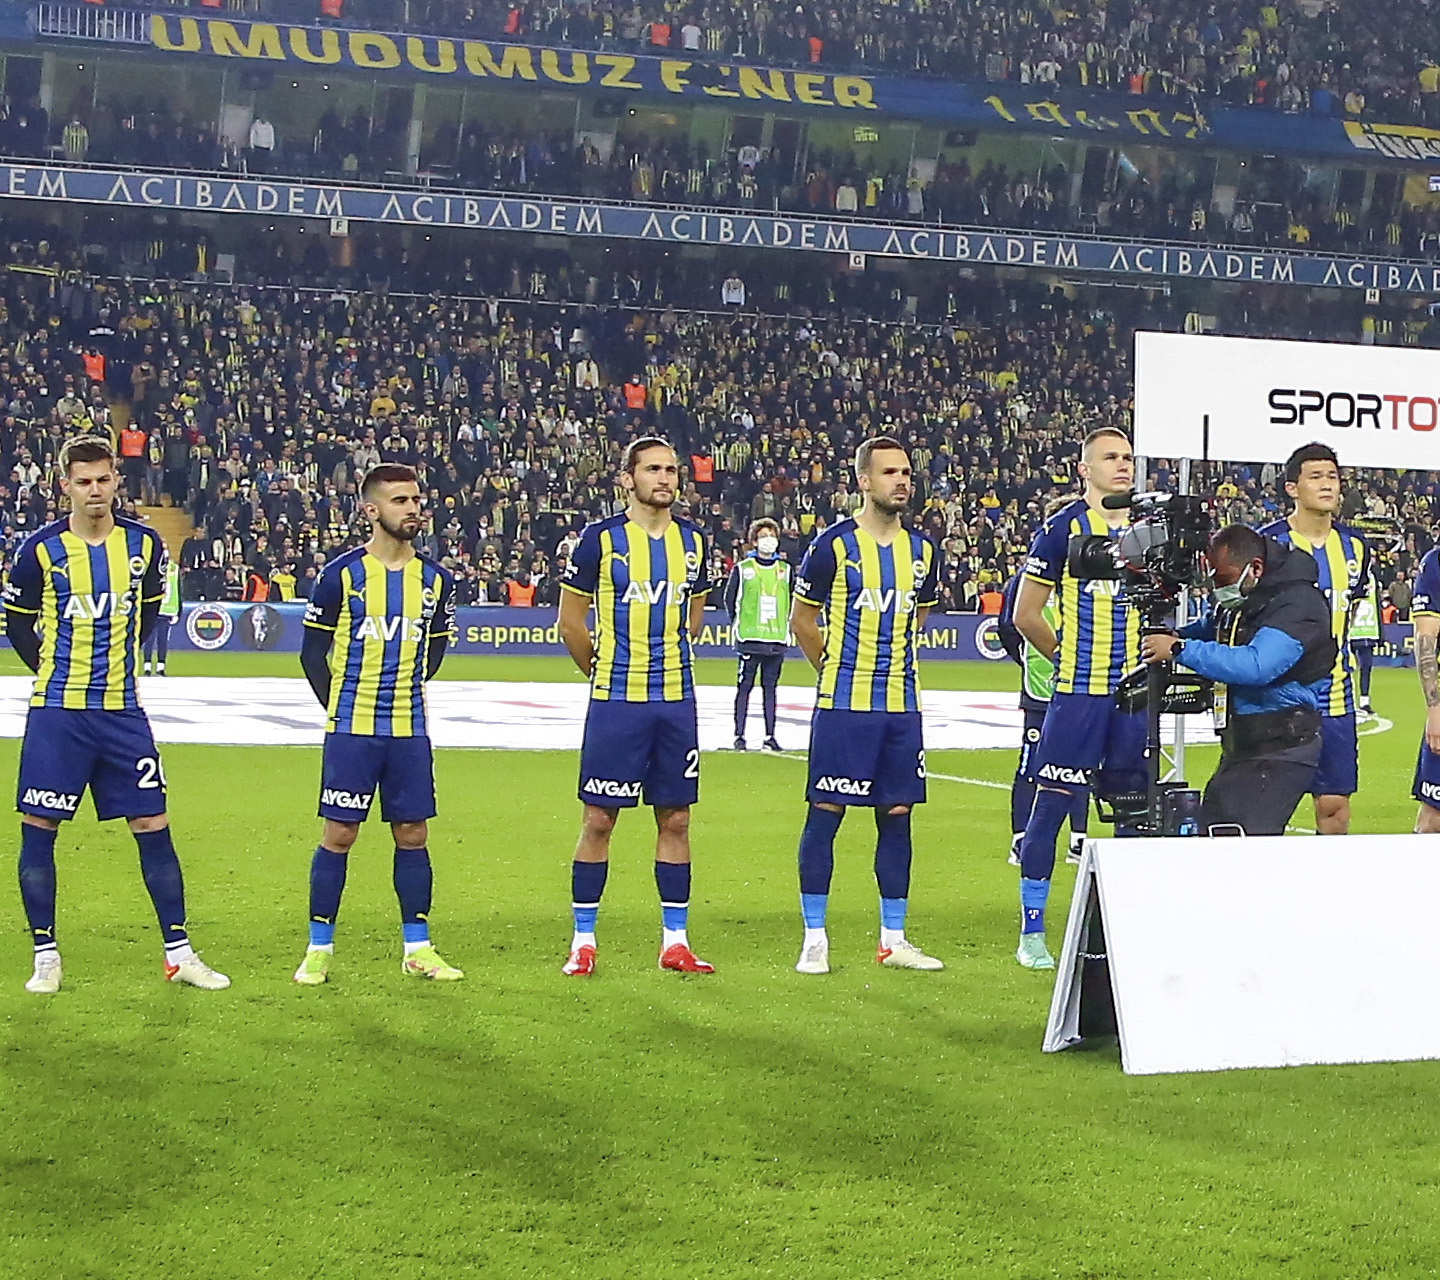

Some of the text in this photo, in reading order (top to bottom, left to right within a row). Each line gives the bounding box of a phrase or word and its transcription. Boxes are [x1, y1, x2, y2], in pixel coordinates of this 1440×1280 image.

[151, 15, 644, 90] UMUDUMUZ
[107, 175, 344, 217] ACIBADEM
[380, 193, 603, 235] ACIBADEM
[641, 213, 850, 251] ACIBADEM
[881, 228, 1080, 269] ACIBADEM
[1108, 247, 1294, 283] ACIBADEM
[621, 580, 689, 606] AVIS
[1084, 578, 1121, 596] AV
[63, 591, 134, 620] AVIS
[852, 588, 917, 615] AVIS
[355, 615, 424, 642] AVIS
[917, 627, 959, 649] AM!
[815, 775, 872, 798] AYGAZ
[1038, 762, 1091, 785] AYGA
[22, 786, 79, 812] AYGAZ
[321, 787, 372, 811] AYGAZ
[582, 776, 642, 799] AYGAZ
